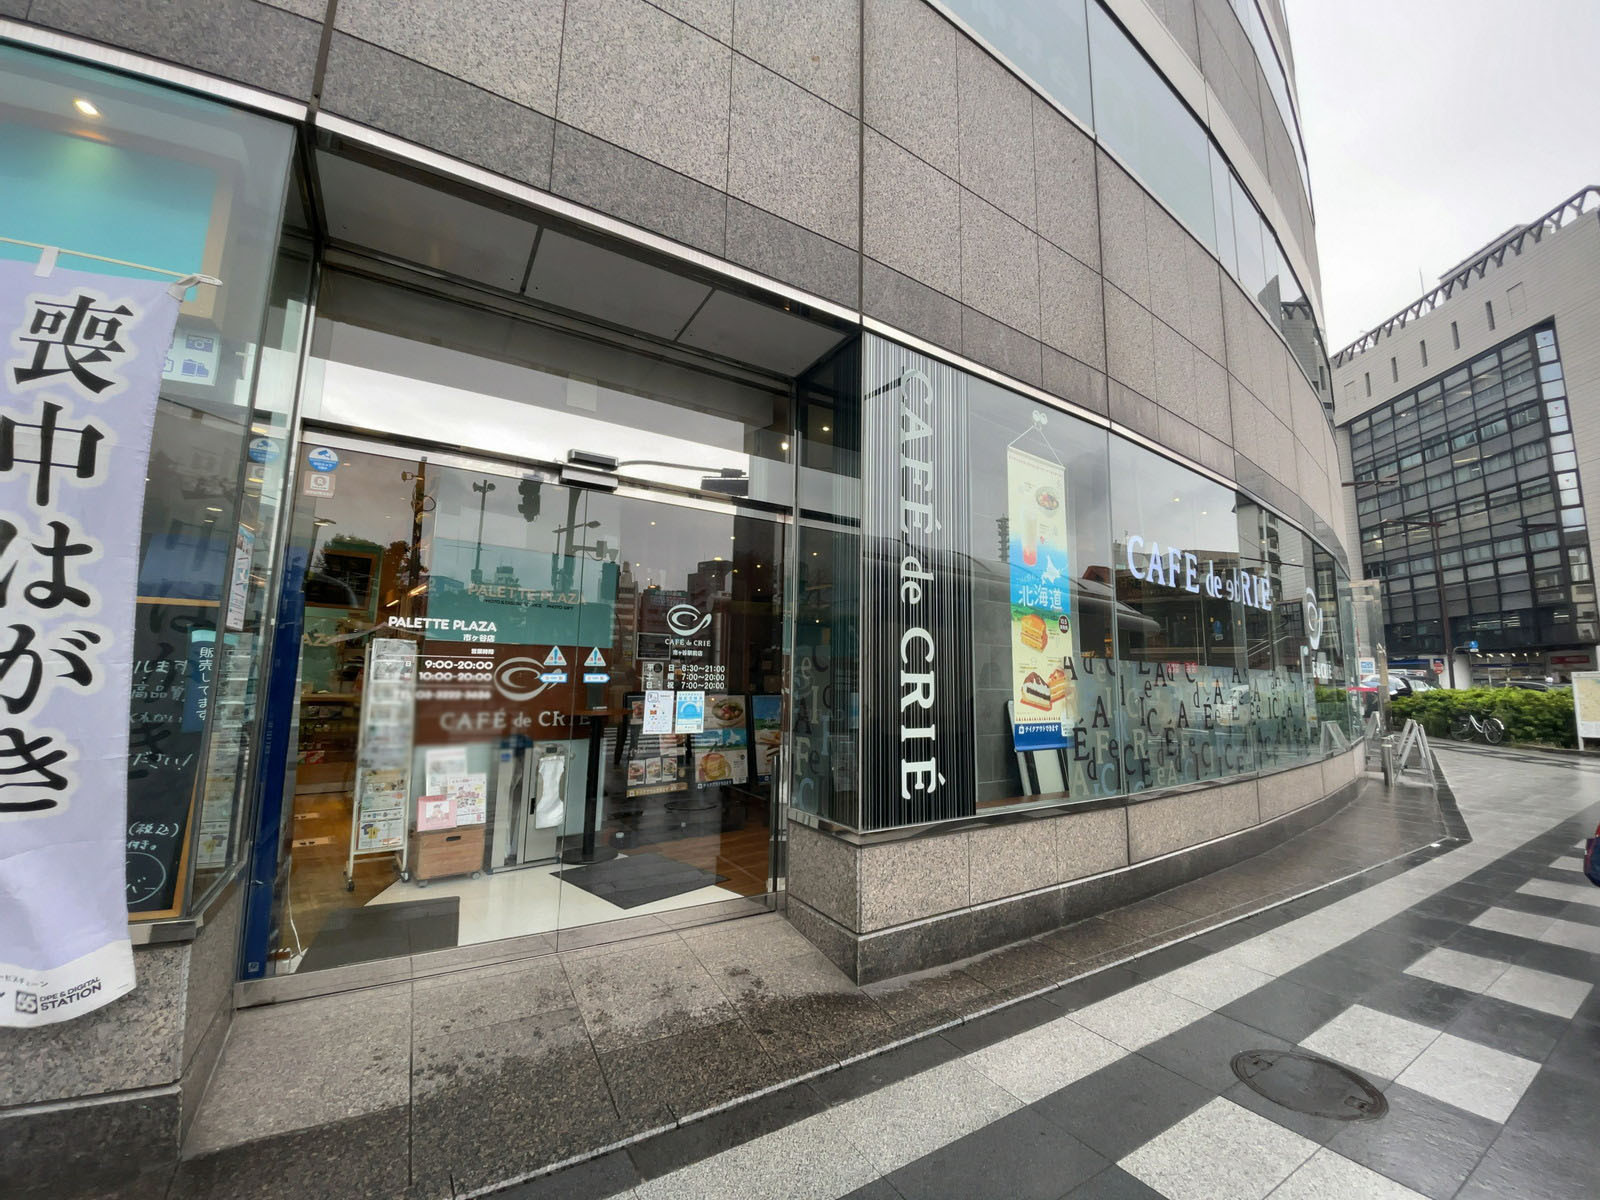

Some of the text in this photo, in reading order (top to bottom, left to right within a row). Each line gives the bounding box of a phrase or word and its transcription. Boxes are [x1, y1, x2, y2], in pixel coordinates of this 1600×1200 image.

[0, 295, 134, 813] 喪中はがき
[900, 368, 945, 800] CAFÉ de CRIÉ
[1205, 560, 1223, 599] de
[468, 583, 537, 601] PALETTE
[540, 589, 587, 605] PLAZA
[1018, 583, 1063, 610] 北海道
[388, 616, 497, 632] PALETTE PLAZA
[425, 660, 494, 670] 9:00-20:00
[196, 647, 214, 720] 販売してます
[419, 672, 493, 682] 10:00-20:00
[440, 709, 507, 731] CAFÉ
[513, 713, 531, 727] de
[128, 822, 179, 837] (税込)
[40, 982, 102, 1011] STATION
[67, 977, 101, 995] DIGITAL
